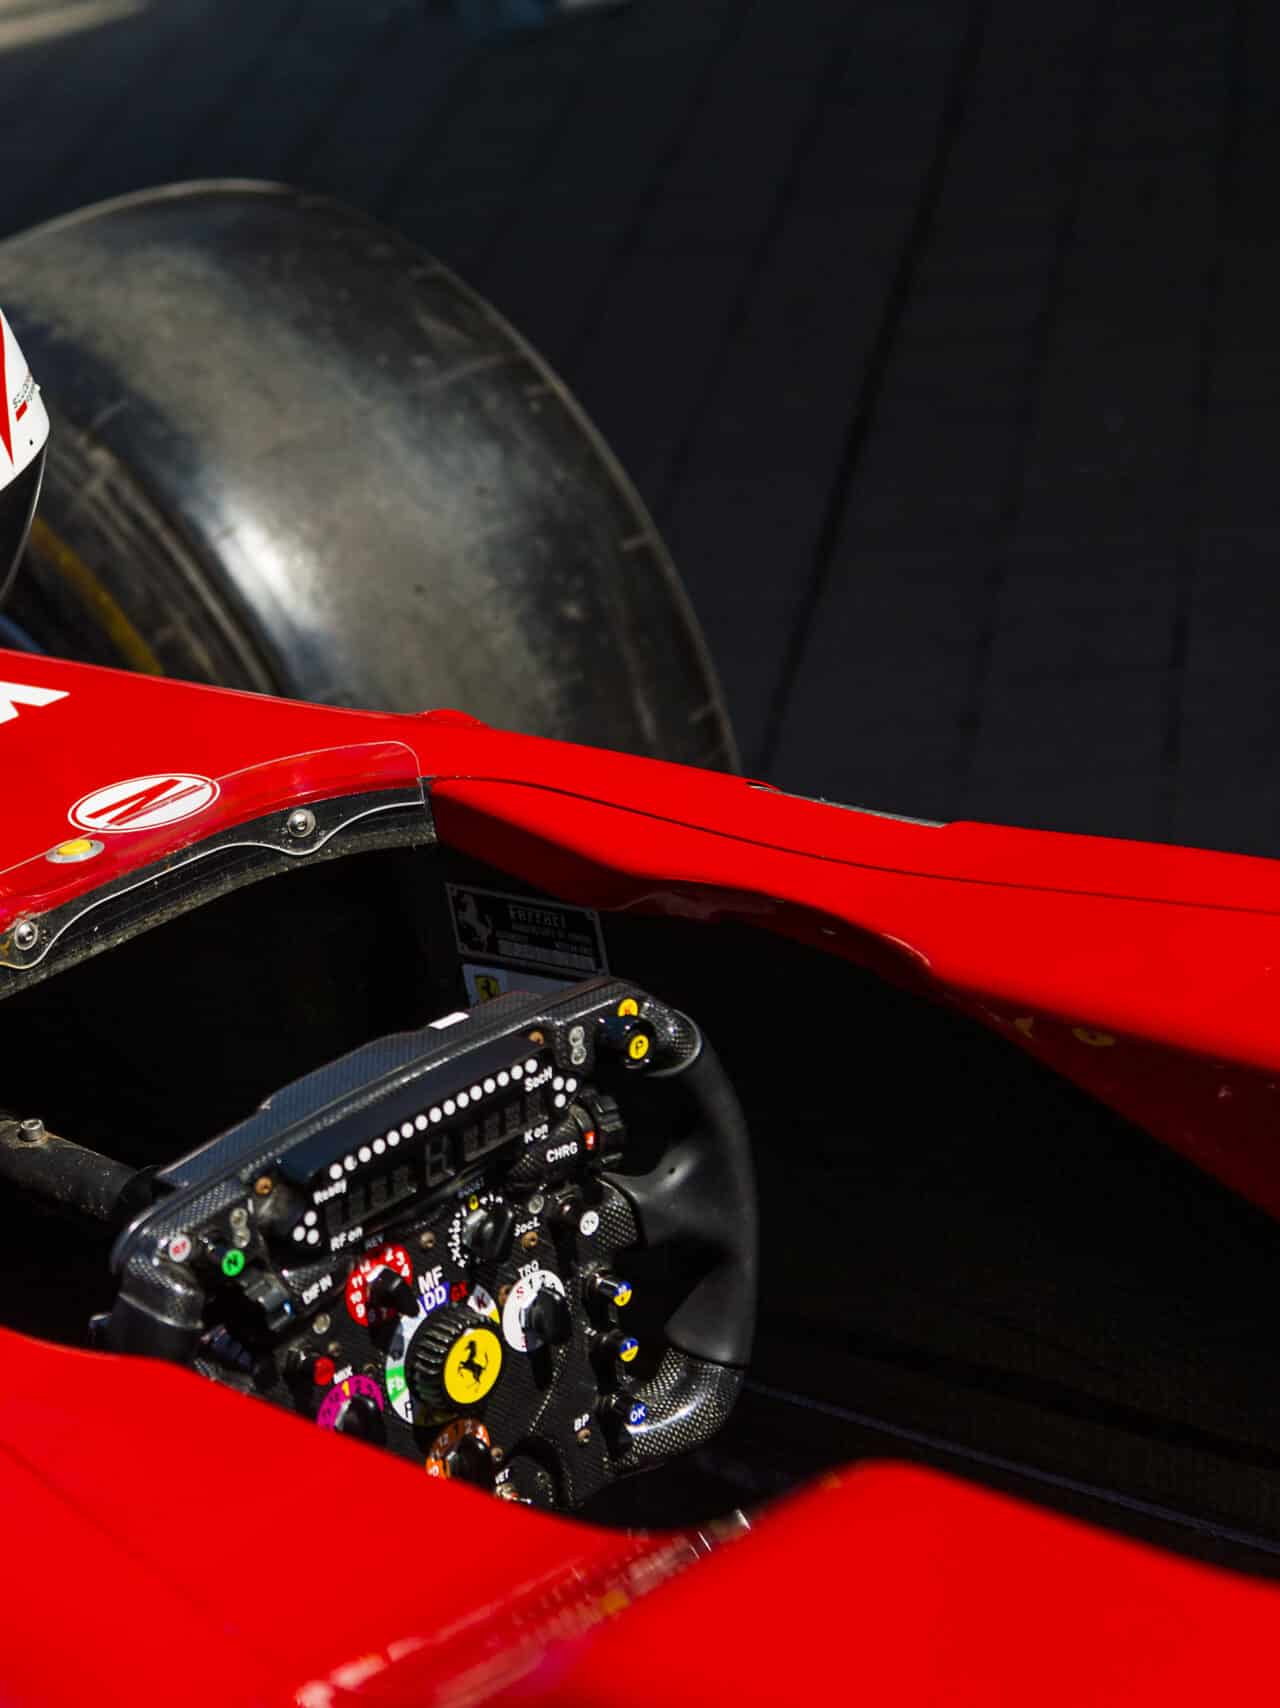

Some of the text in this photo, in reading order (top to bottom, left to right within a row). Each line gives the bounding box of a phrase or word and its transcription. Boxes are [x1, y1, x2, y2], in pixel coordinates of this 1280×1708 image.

[86, 778, 206, 826] N
[545, 1141, 578, 1163] CHRG
[417, 1265, 444, 1294] MF
[573, 1412, 591, 1432] BP
[630, 1404, 646, 1421] OK
